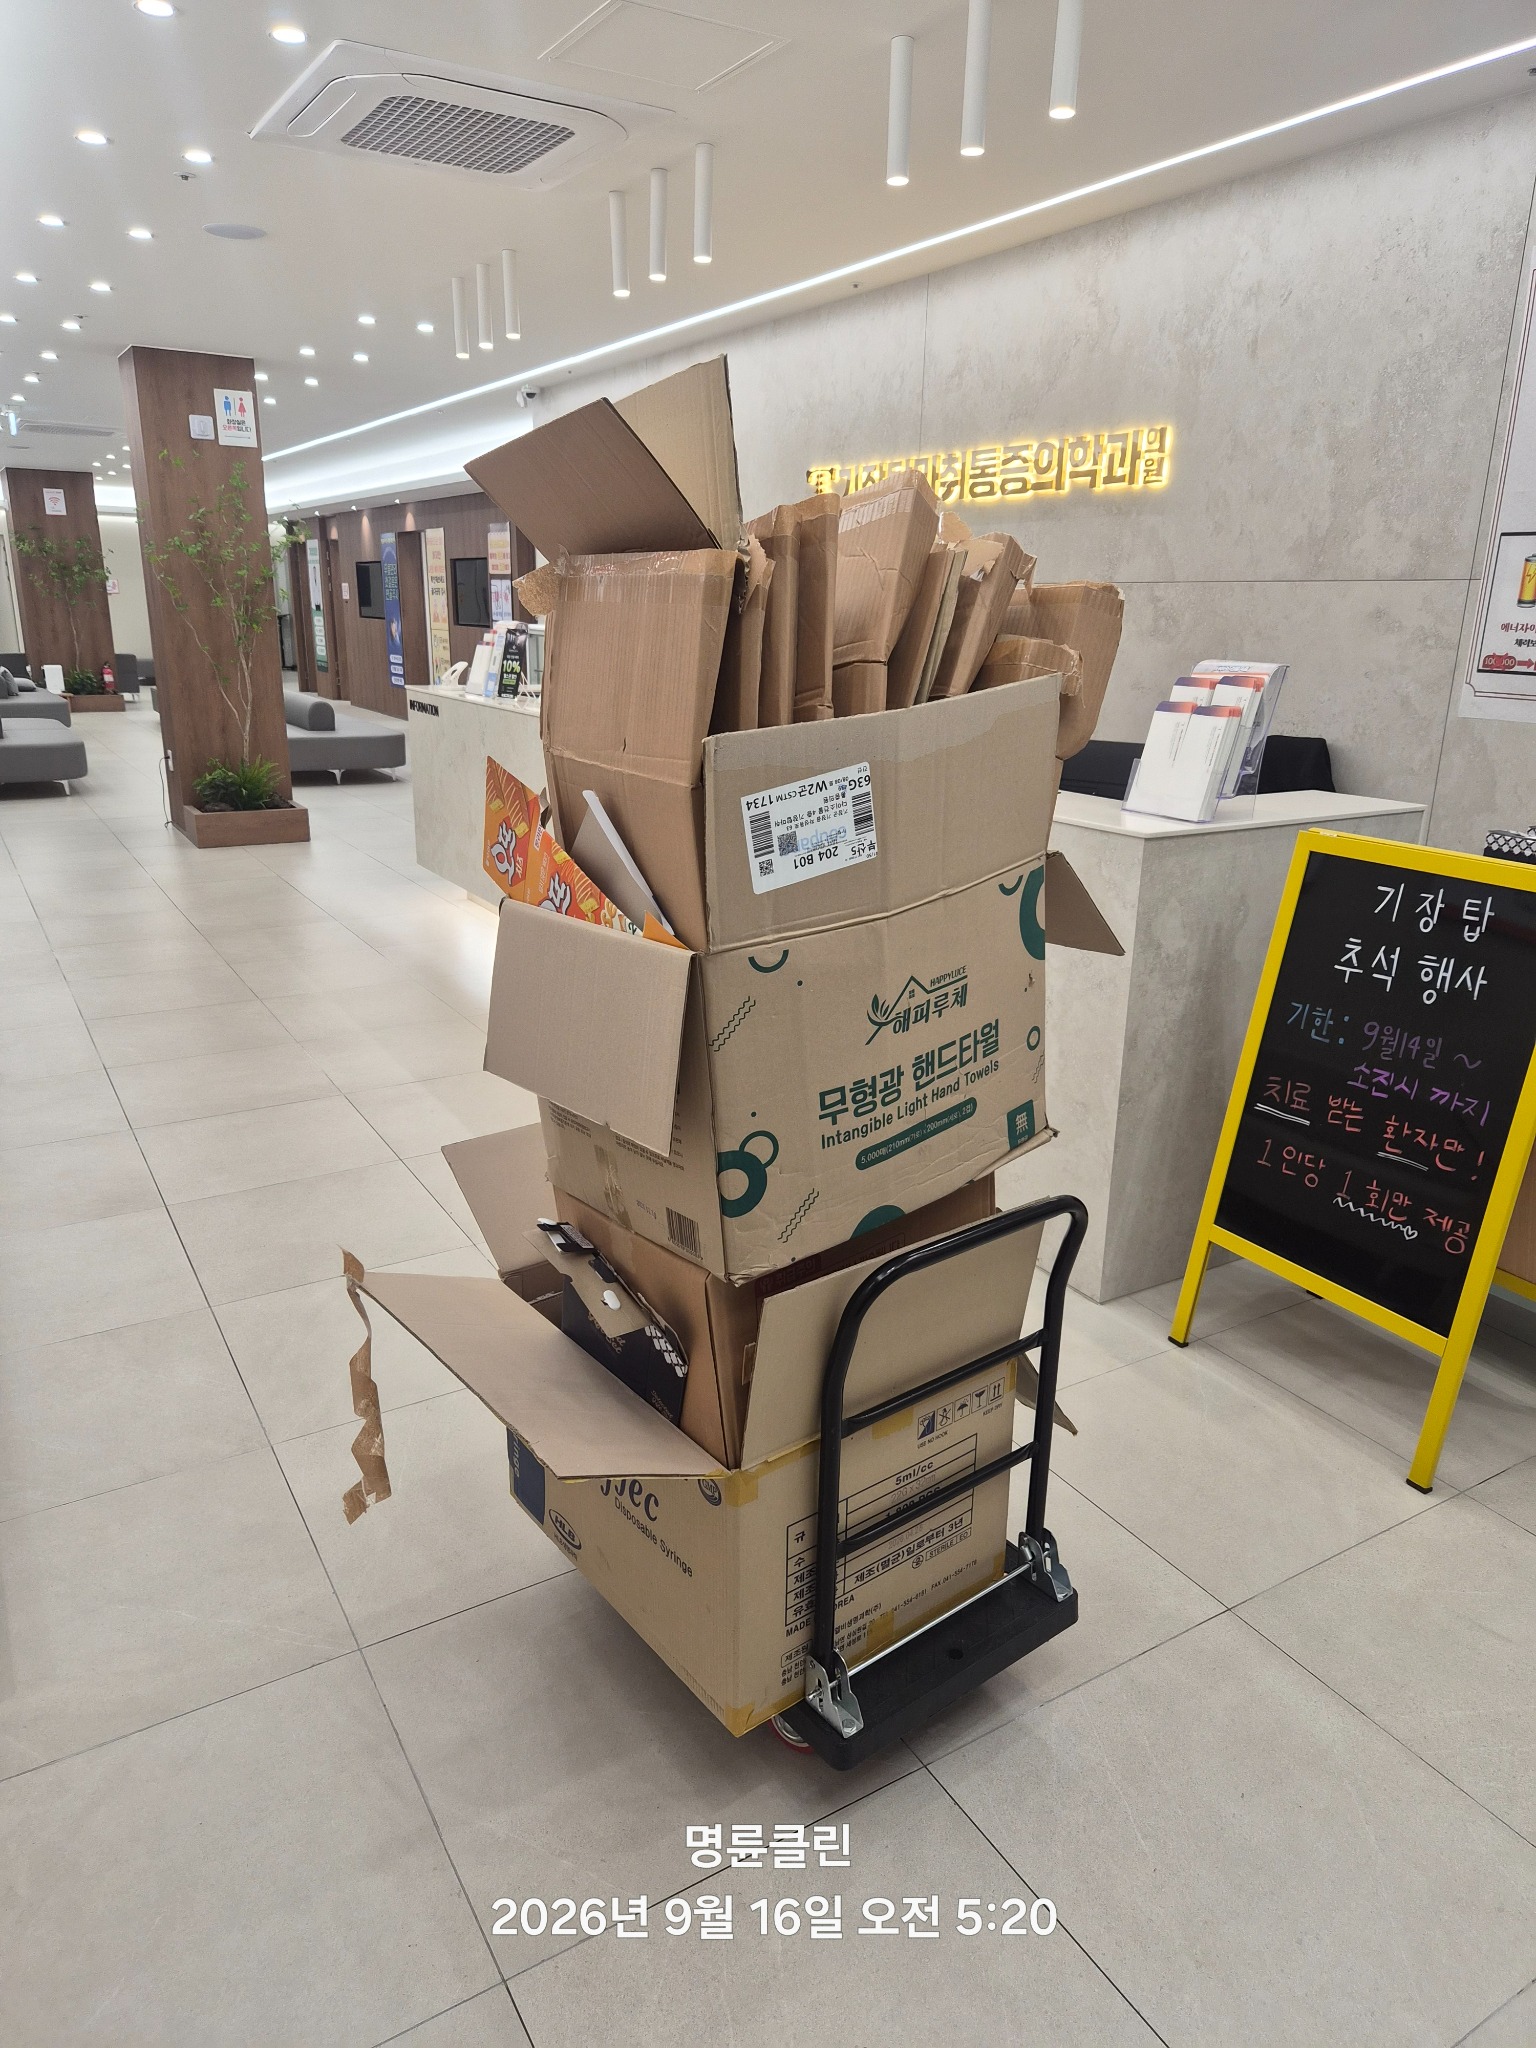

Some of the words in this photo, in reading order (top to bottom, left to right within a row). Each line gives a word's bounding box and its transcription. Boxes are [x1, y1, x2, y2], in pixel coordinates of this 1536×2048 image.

[502, 659, 521, 673] 10%
[409, 699, 439, 717] INFORMATION
[848, 774, 871, 791] 63G
[746, 794, 774, 811] 1734
[775, 790, 798, 803] CSTM
[818, 846, 839, 862] 204
[851, 840, 877, 857] 부산5
[793, 854, 814, 870] B01
[930, 965, 967, 987] HAPPYLUCE
[1334, 937, 1400, 993] 추석
[1417, 952, 1488, 1005] 행사
[892, 982, 968, 1035] 해피루체
[818, 1065, 904, 1126] 무형광
[912, 1018, 1000, 1092] 핸드타월
[1347, 1062, 1419, 1100] 소진시
[1430, 1087, 1492, 1127] 까지
[821, 1113, 893, 1150] Intangible
[897, 1093, 928, 1120] Light
[931, 1077, 960, 1103] Hand
[964, 1059, 999, 1086] Towels
[1263, 1076, 1311, 1113] 치료
[1327, 1094, 1364, 1134] 받는
[1015, 1112, 1028, 1135] 無
[1423, 1207, 1472, 1255] 제공
[895, 1462, 934, 1485] 5ml/cc
[554, 1515, 576, 1542] HLB
[948, 1516, 964, 1533] 3년
[615, 1496, 658, 1545] Disposable
[660, 1539, 693, 1577] Syringe
[794, 1530, 806, 1543] 규
[929, 1539, 954, 1558] STERILE
[793, 1556, 805, 1567] 수
[786, 1618, 811, 1637] MADE
